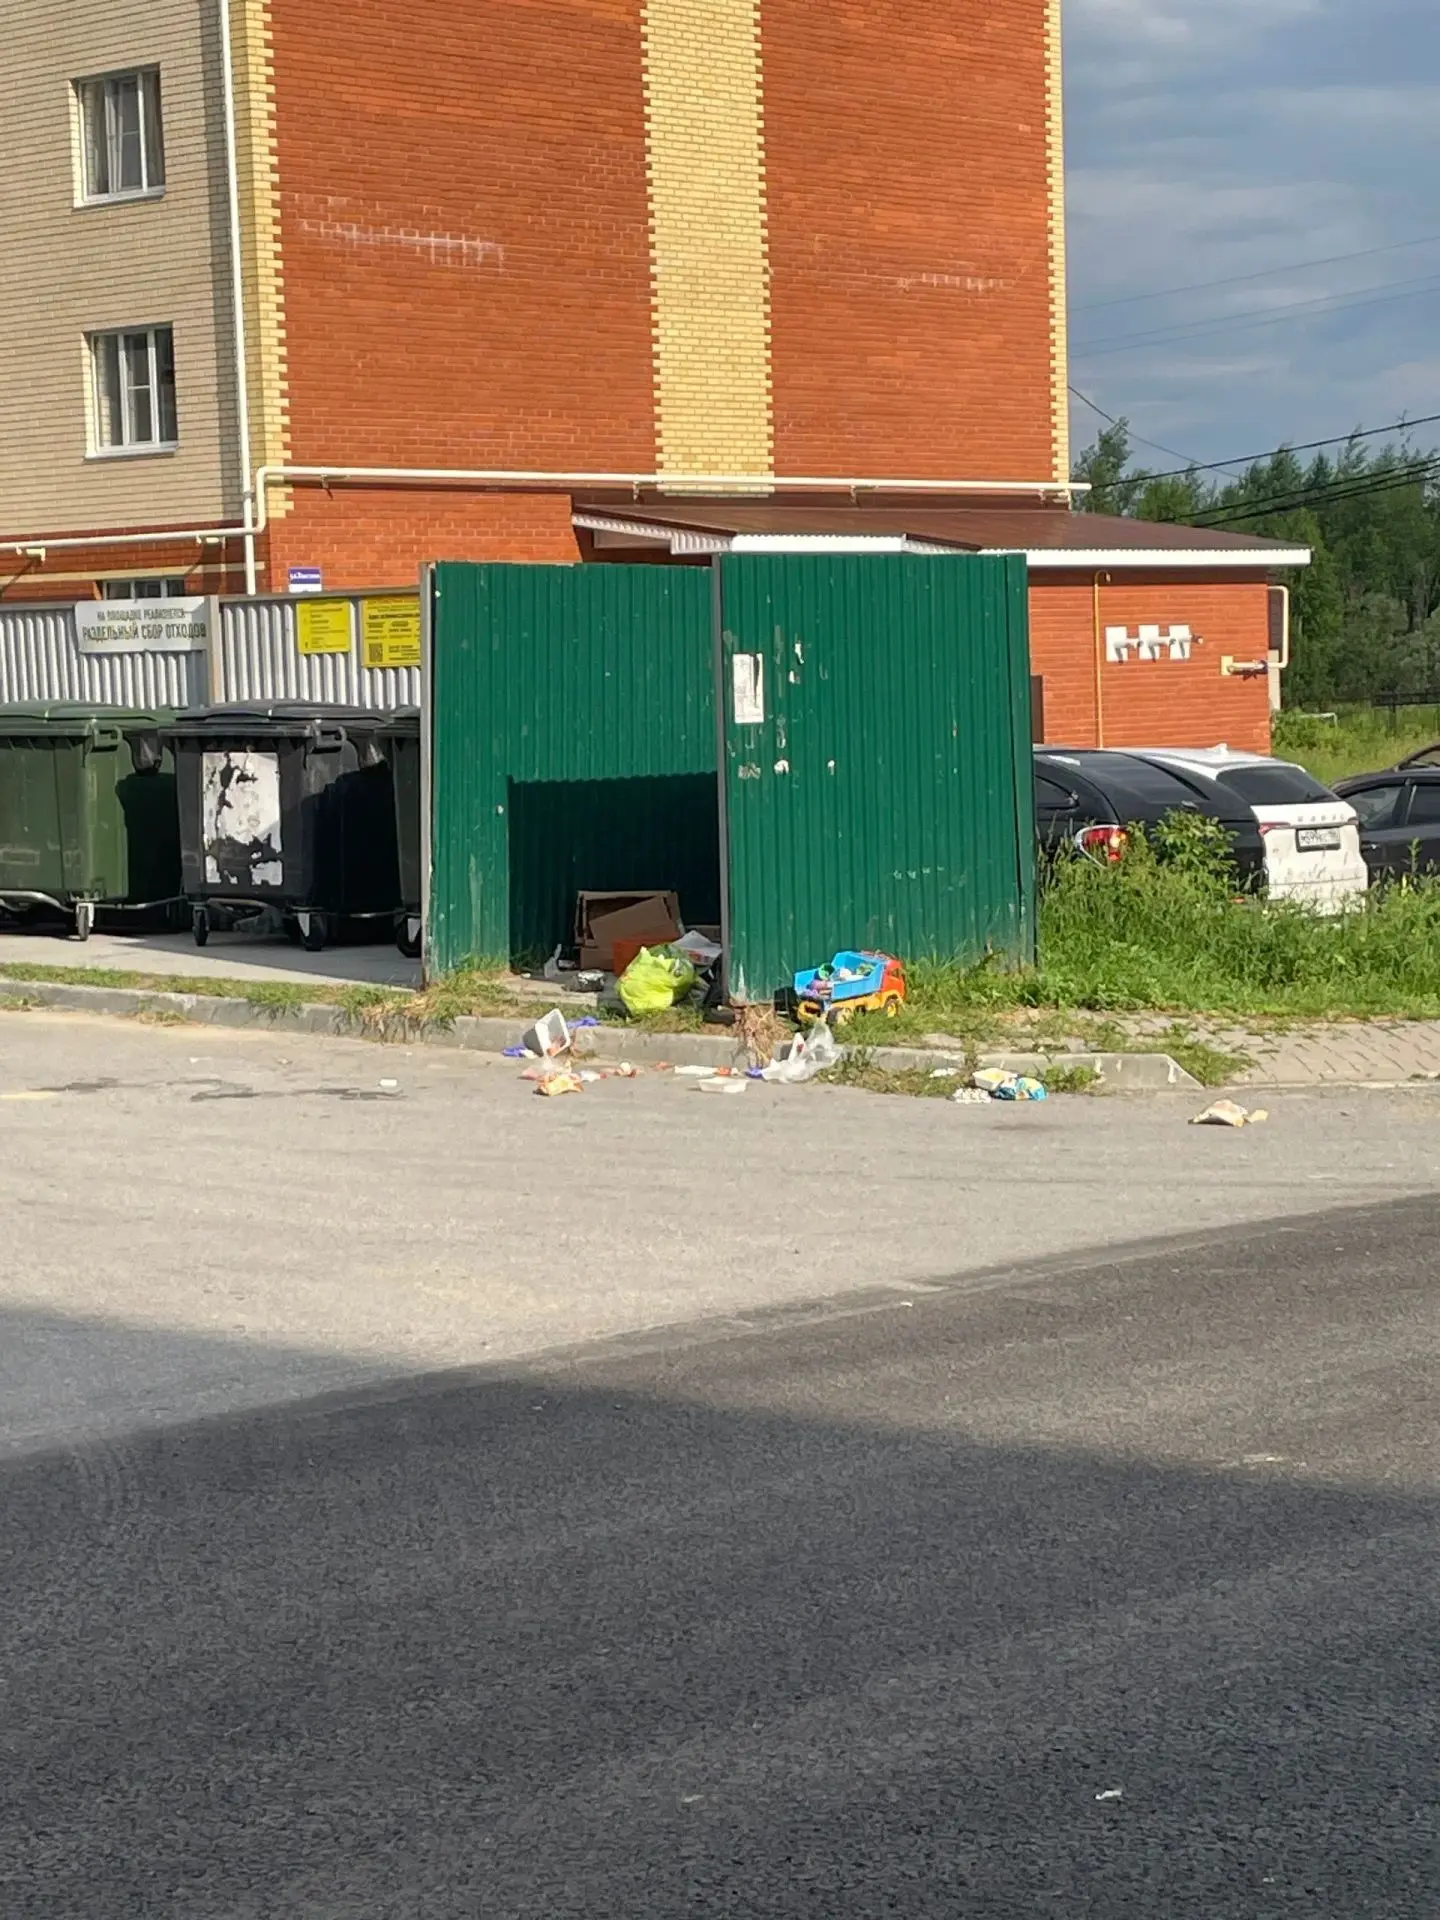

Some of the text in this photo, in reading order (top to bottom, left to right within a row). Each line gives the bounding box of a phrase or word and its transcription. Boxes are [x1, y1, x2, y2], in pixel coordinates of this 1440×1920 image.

[82, 622, 207, 641] РАЗДЕЛЬНЫЙ СБОР ОТХОДОВ
